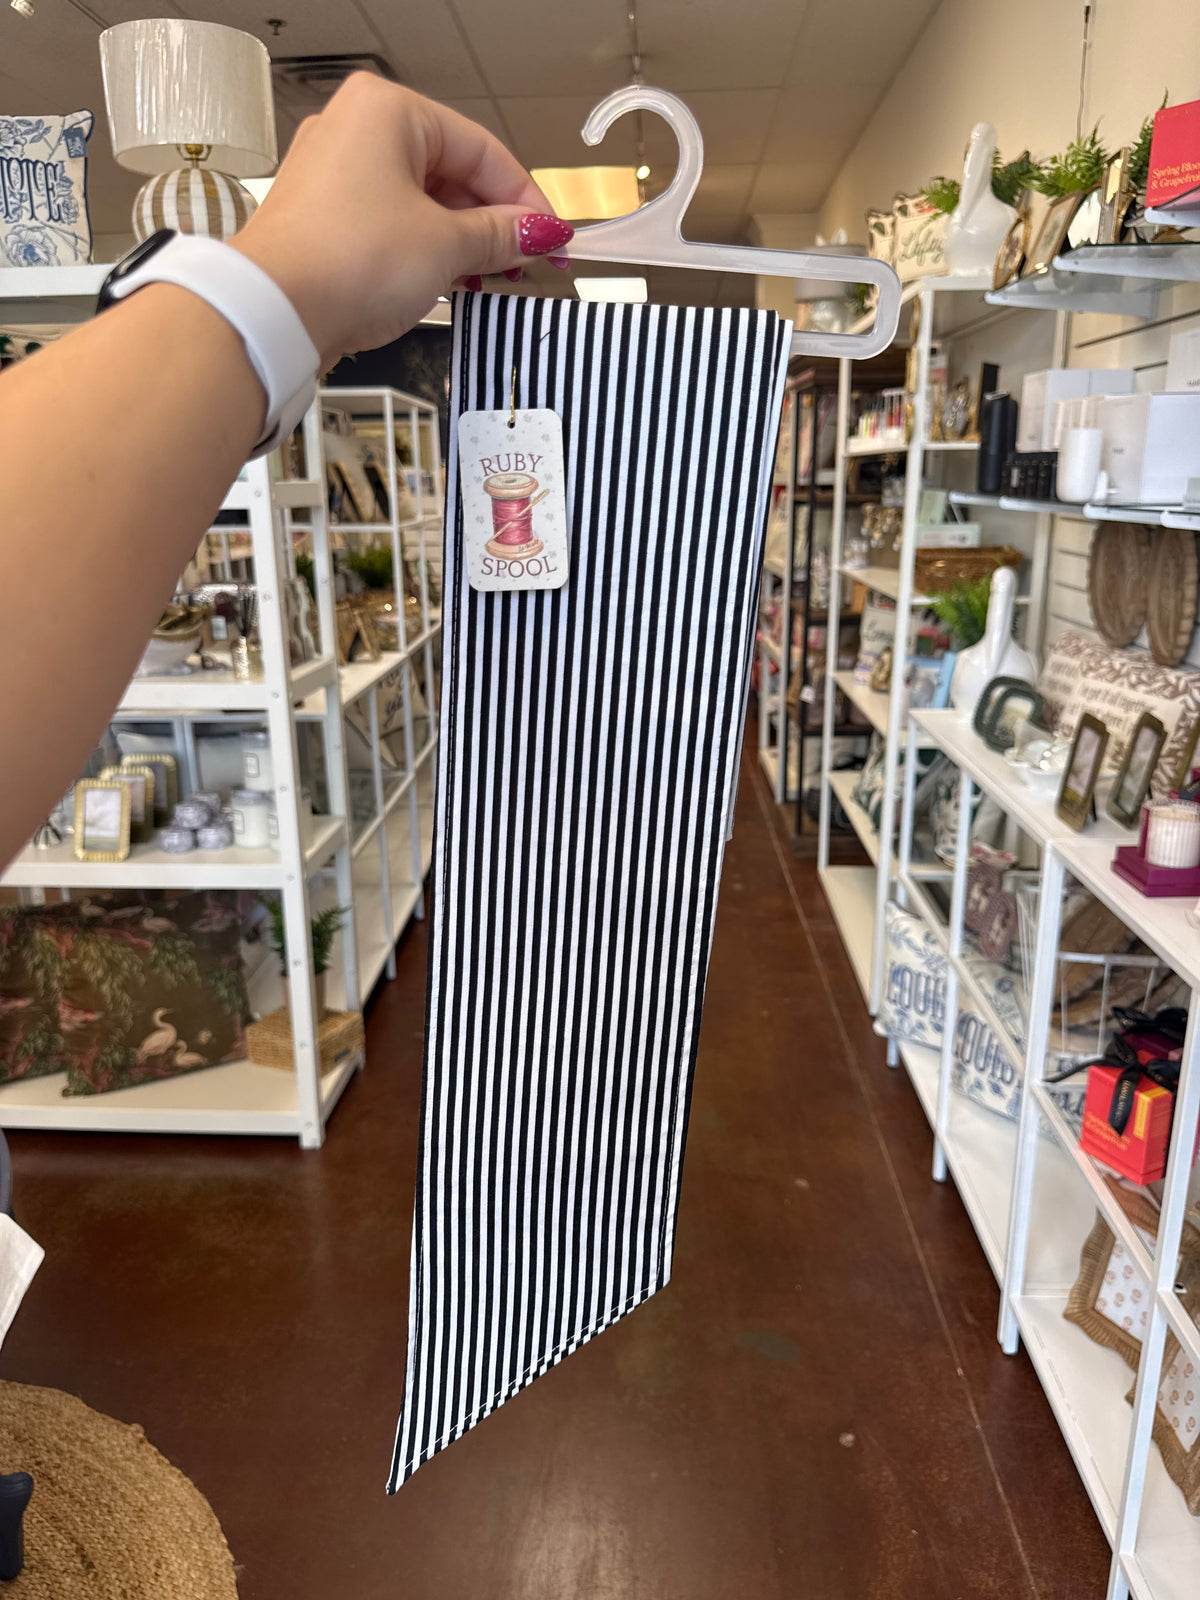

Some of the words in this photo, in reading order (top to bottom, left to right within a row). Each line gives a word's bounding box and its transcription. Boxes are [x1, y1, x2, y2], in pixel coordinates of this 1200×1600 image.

[1151, 166, 1180, 179] Spring
[1150, 179, 1158, 190] &
[479, 452, 544, 477] RUBY
[480, 555, 558, 578] SPOOL
